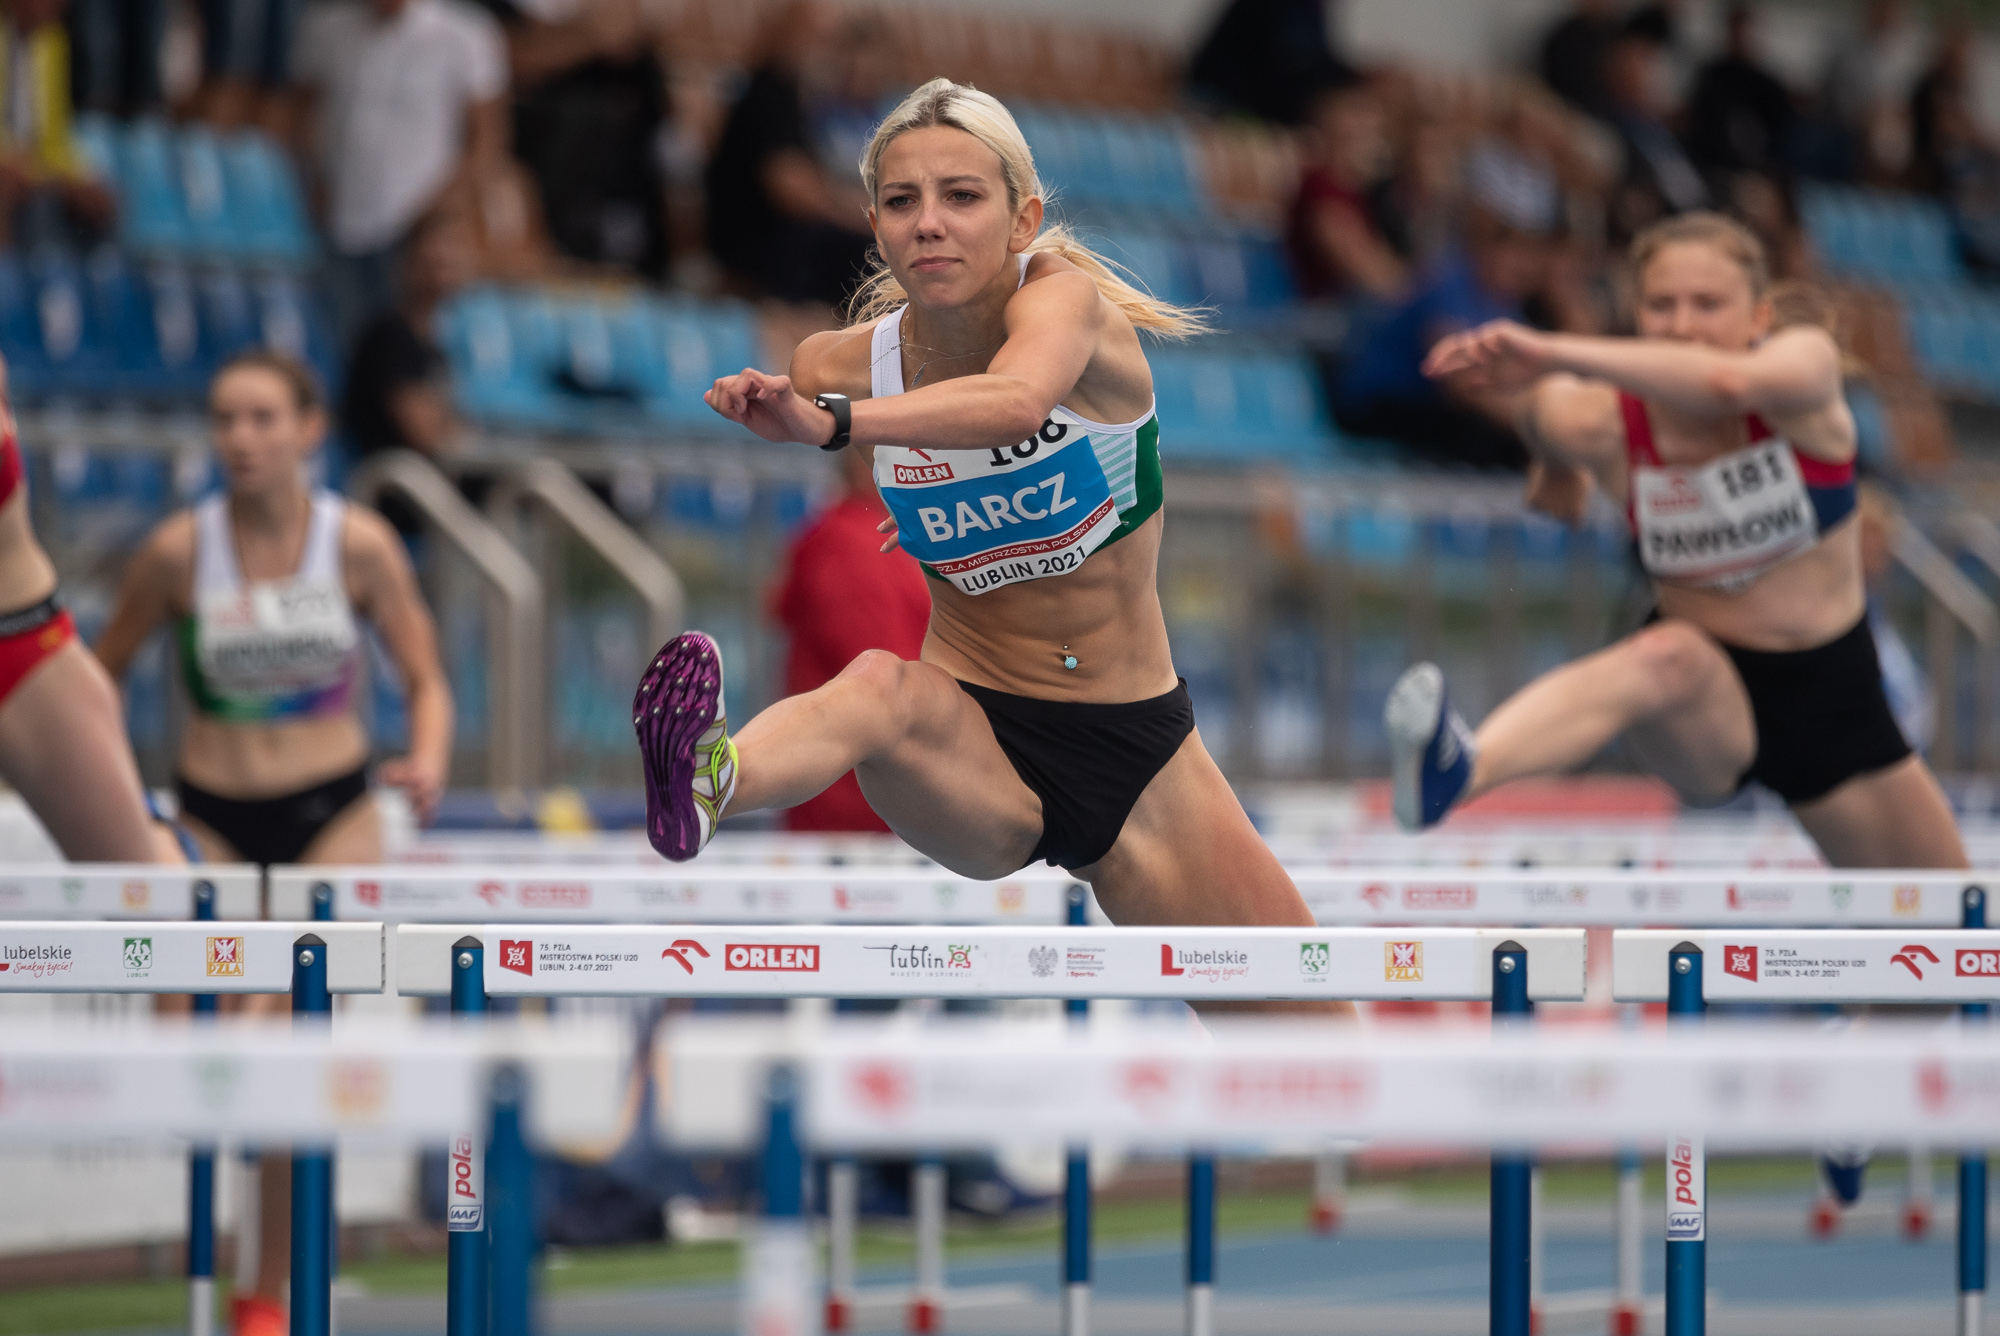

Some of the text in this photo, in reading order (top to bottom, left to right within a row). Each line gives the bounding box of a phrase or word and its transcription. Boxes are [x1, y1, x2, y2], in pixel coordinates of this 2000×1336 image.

[896, 464, 950, 483] ORLEN
[917, 472, 1077, 543] BARCZ
[936, 505, 1109, 573] PZLA MISTRZOSTWA POLSKI U20
[962, 545, 1086, 592] LUBLIN 2021
[729, 947, 815, 969] ORLEN
[1778, 949, 1797, 957] PZLA
[13, 961, 46, 978] Smakuj
[208, 963, 242, 975] PZLA
[569, 964, 613, 972] 2-4.07.2021
[1960, 953, 2000, 974] OR
[1386, 969, 1421, 980] PZLA
[450, 1210, 479, 1219] IAAF
[1670, 1217, 1699, 1227] IAAF
